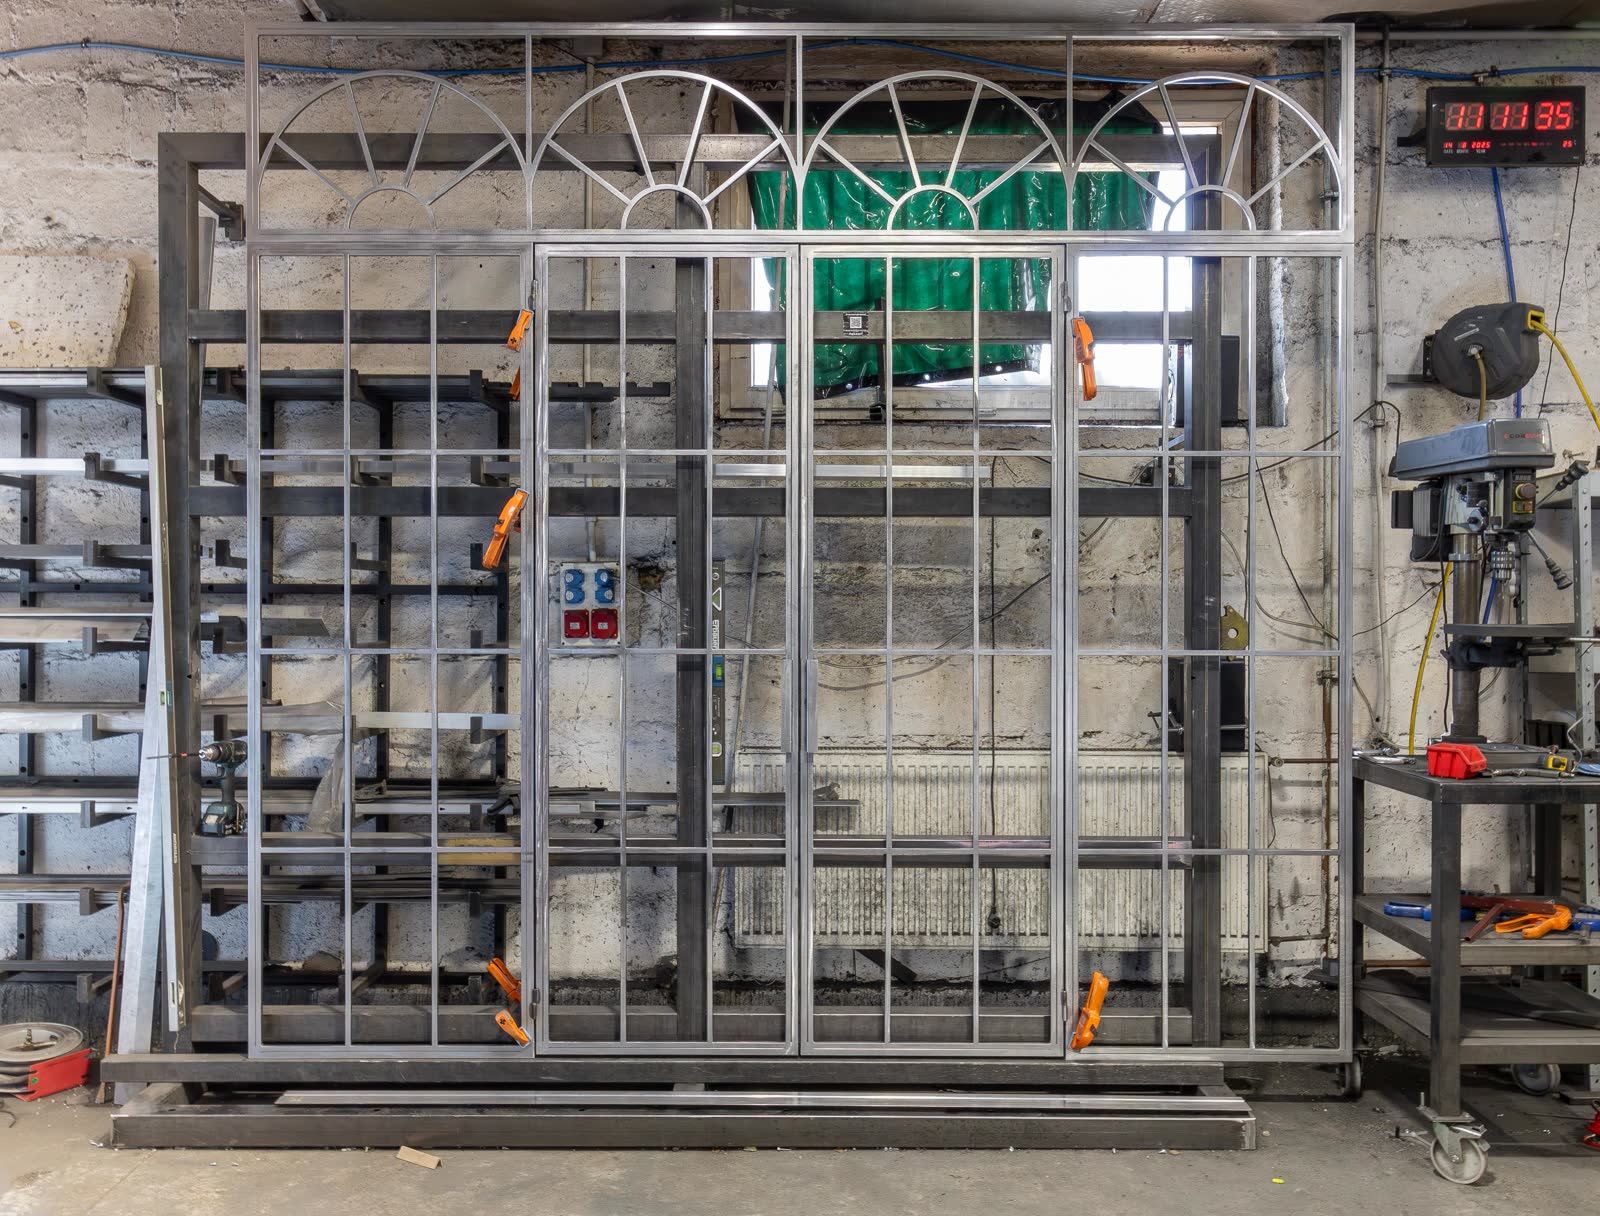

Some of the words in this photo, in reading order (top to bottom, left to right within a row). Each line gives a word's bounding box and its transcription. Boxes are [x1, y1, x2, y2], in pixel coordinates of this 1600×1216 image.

[1456, 103, 1485, 129] 11
[1501, 103, 1529, 129] 11
[1535, 101, 1573, 131] 35
[1471, 141, 1491, 149] 2025
